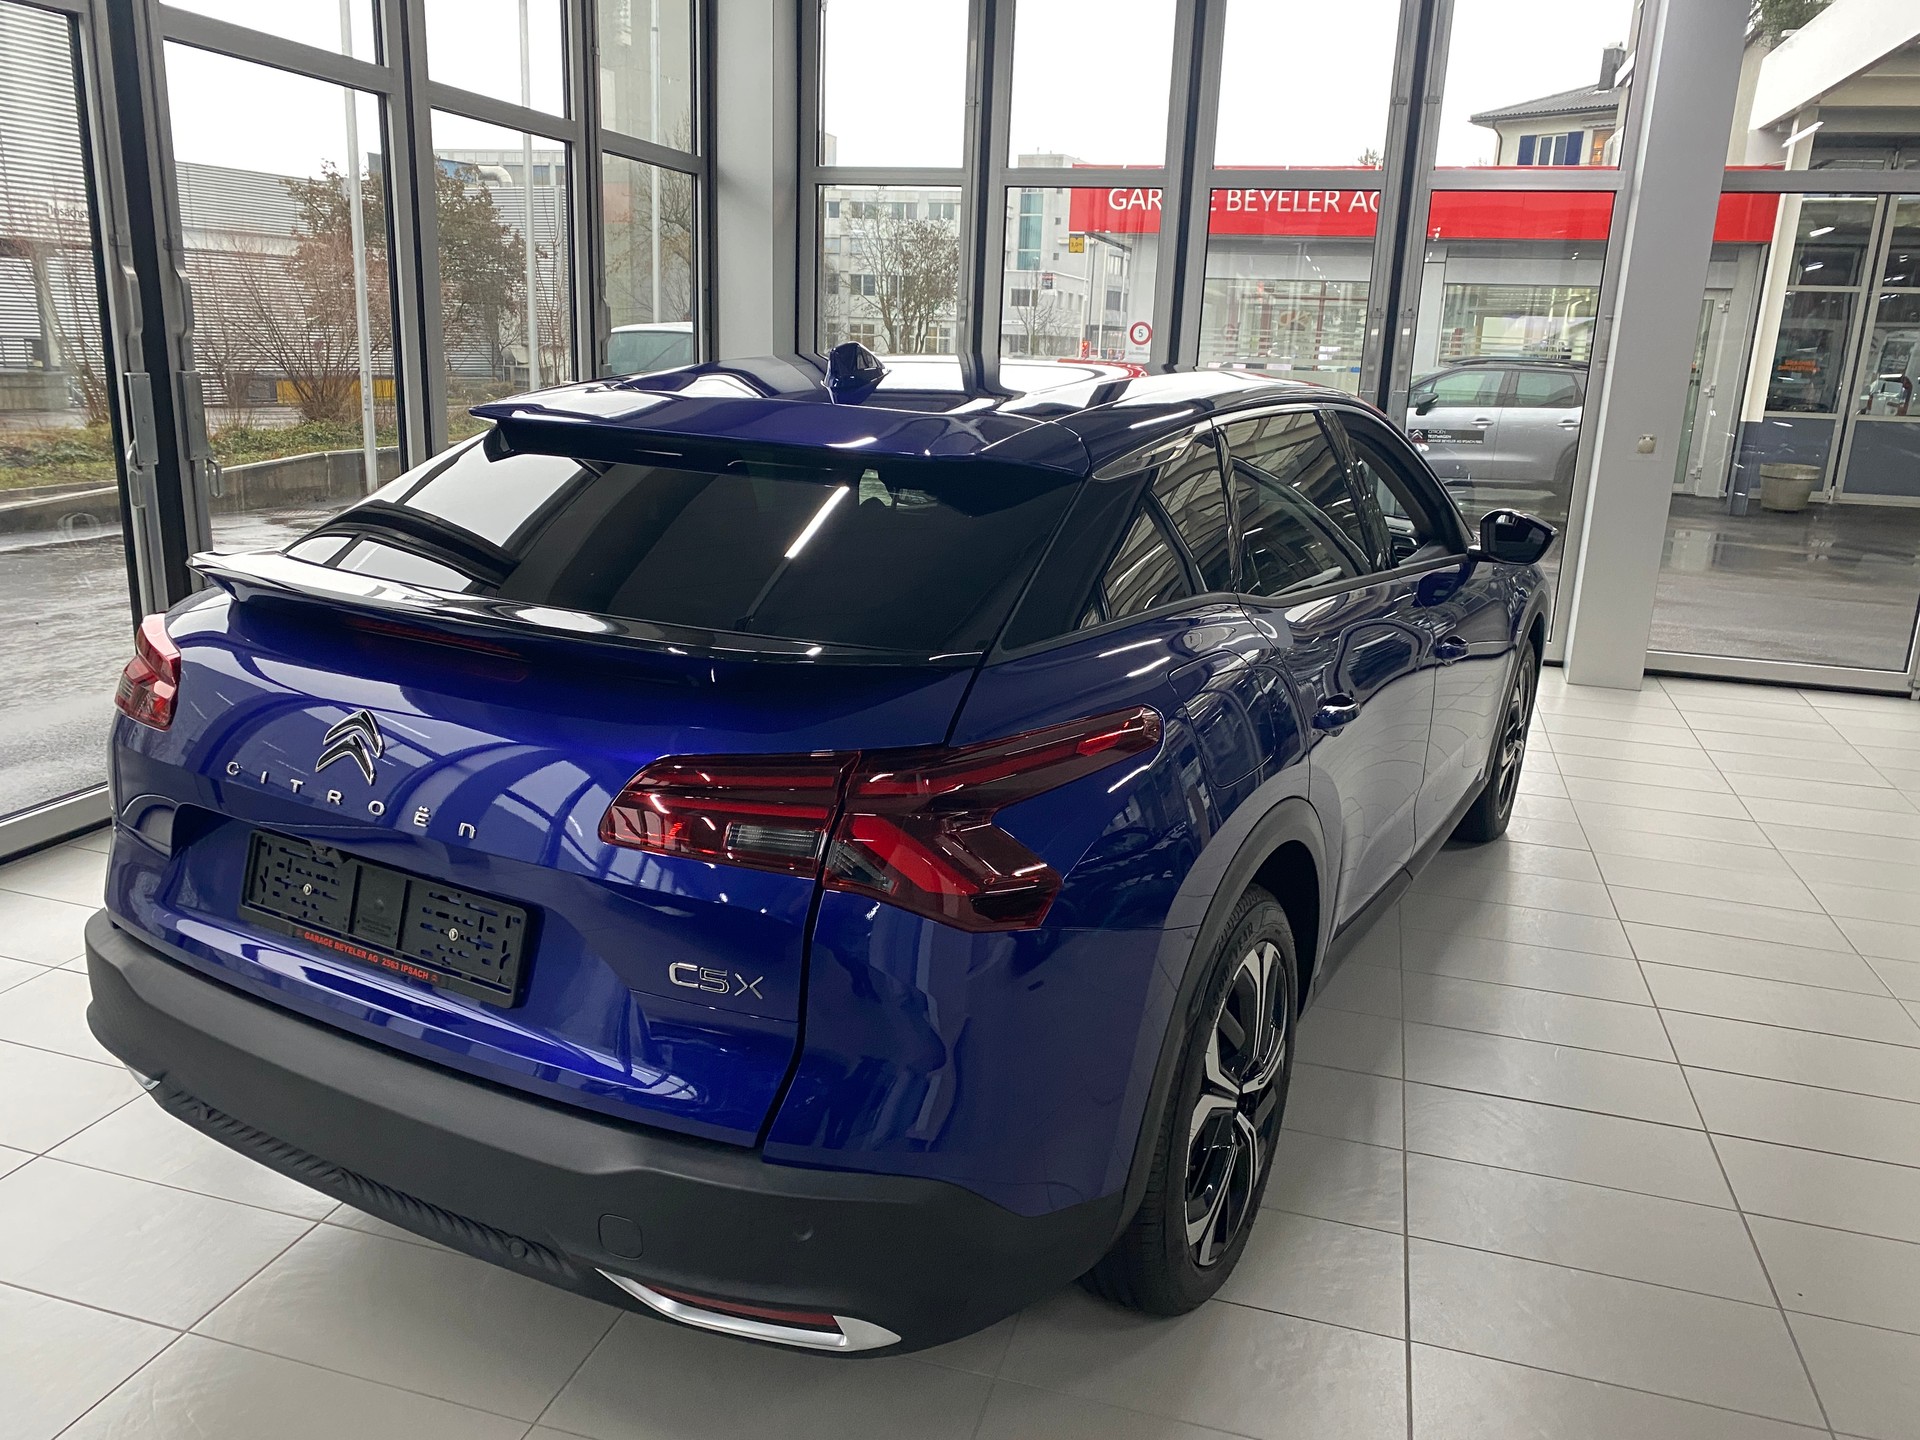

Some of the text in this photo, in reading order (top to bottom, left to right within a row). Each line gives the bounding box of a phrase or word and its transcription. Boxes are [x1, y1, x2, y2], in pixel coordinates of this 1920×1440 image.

[1226, 189, 1340, 213] BEYELER
[1138, 328, 1144, 338] 5
[304, 931, 333, 948] GARAGE
[334, 939, 367, 959] BEYELER
[367, 953, 379, 963] AG
[400, 963, 429, 980] IPSACH
